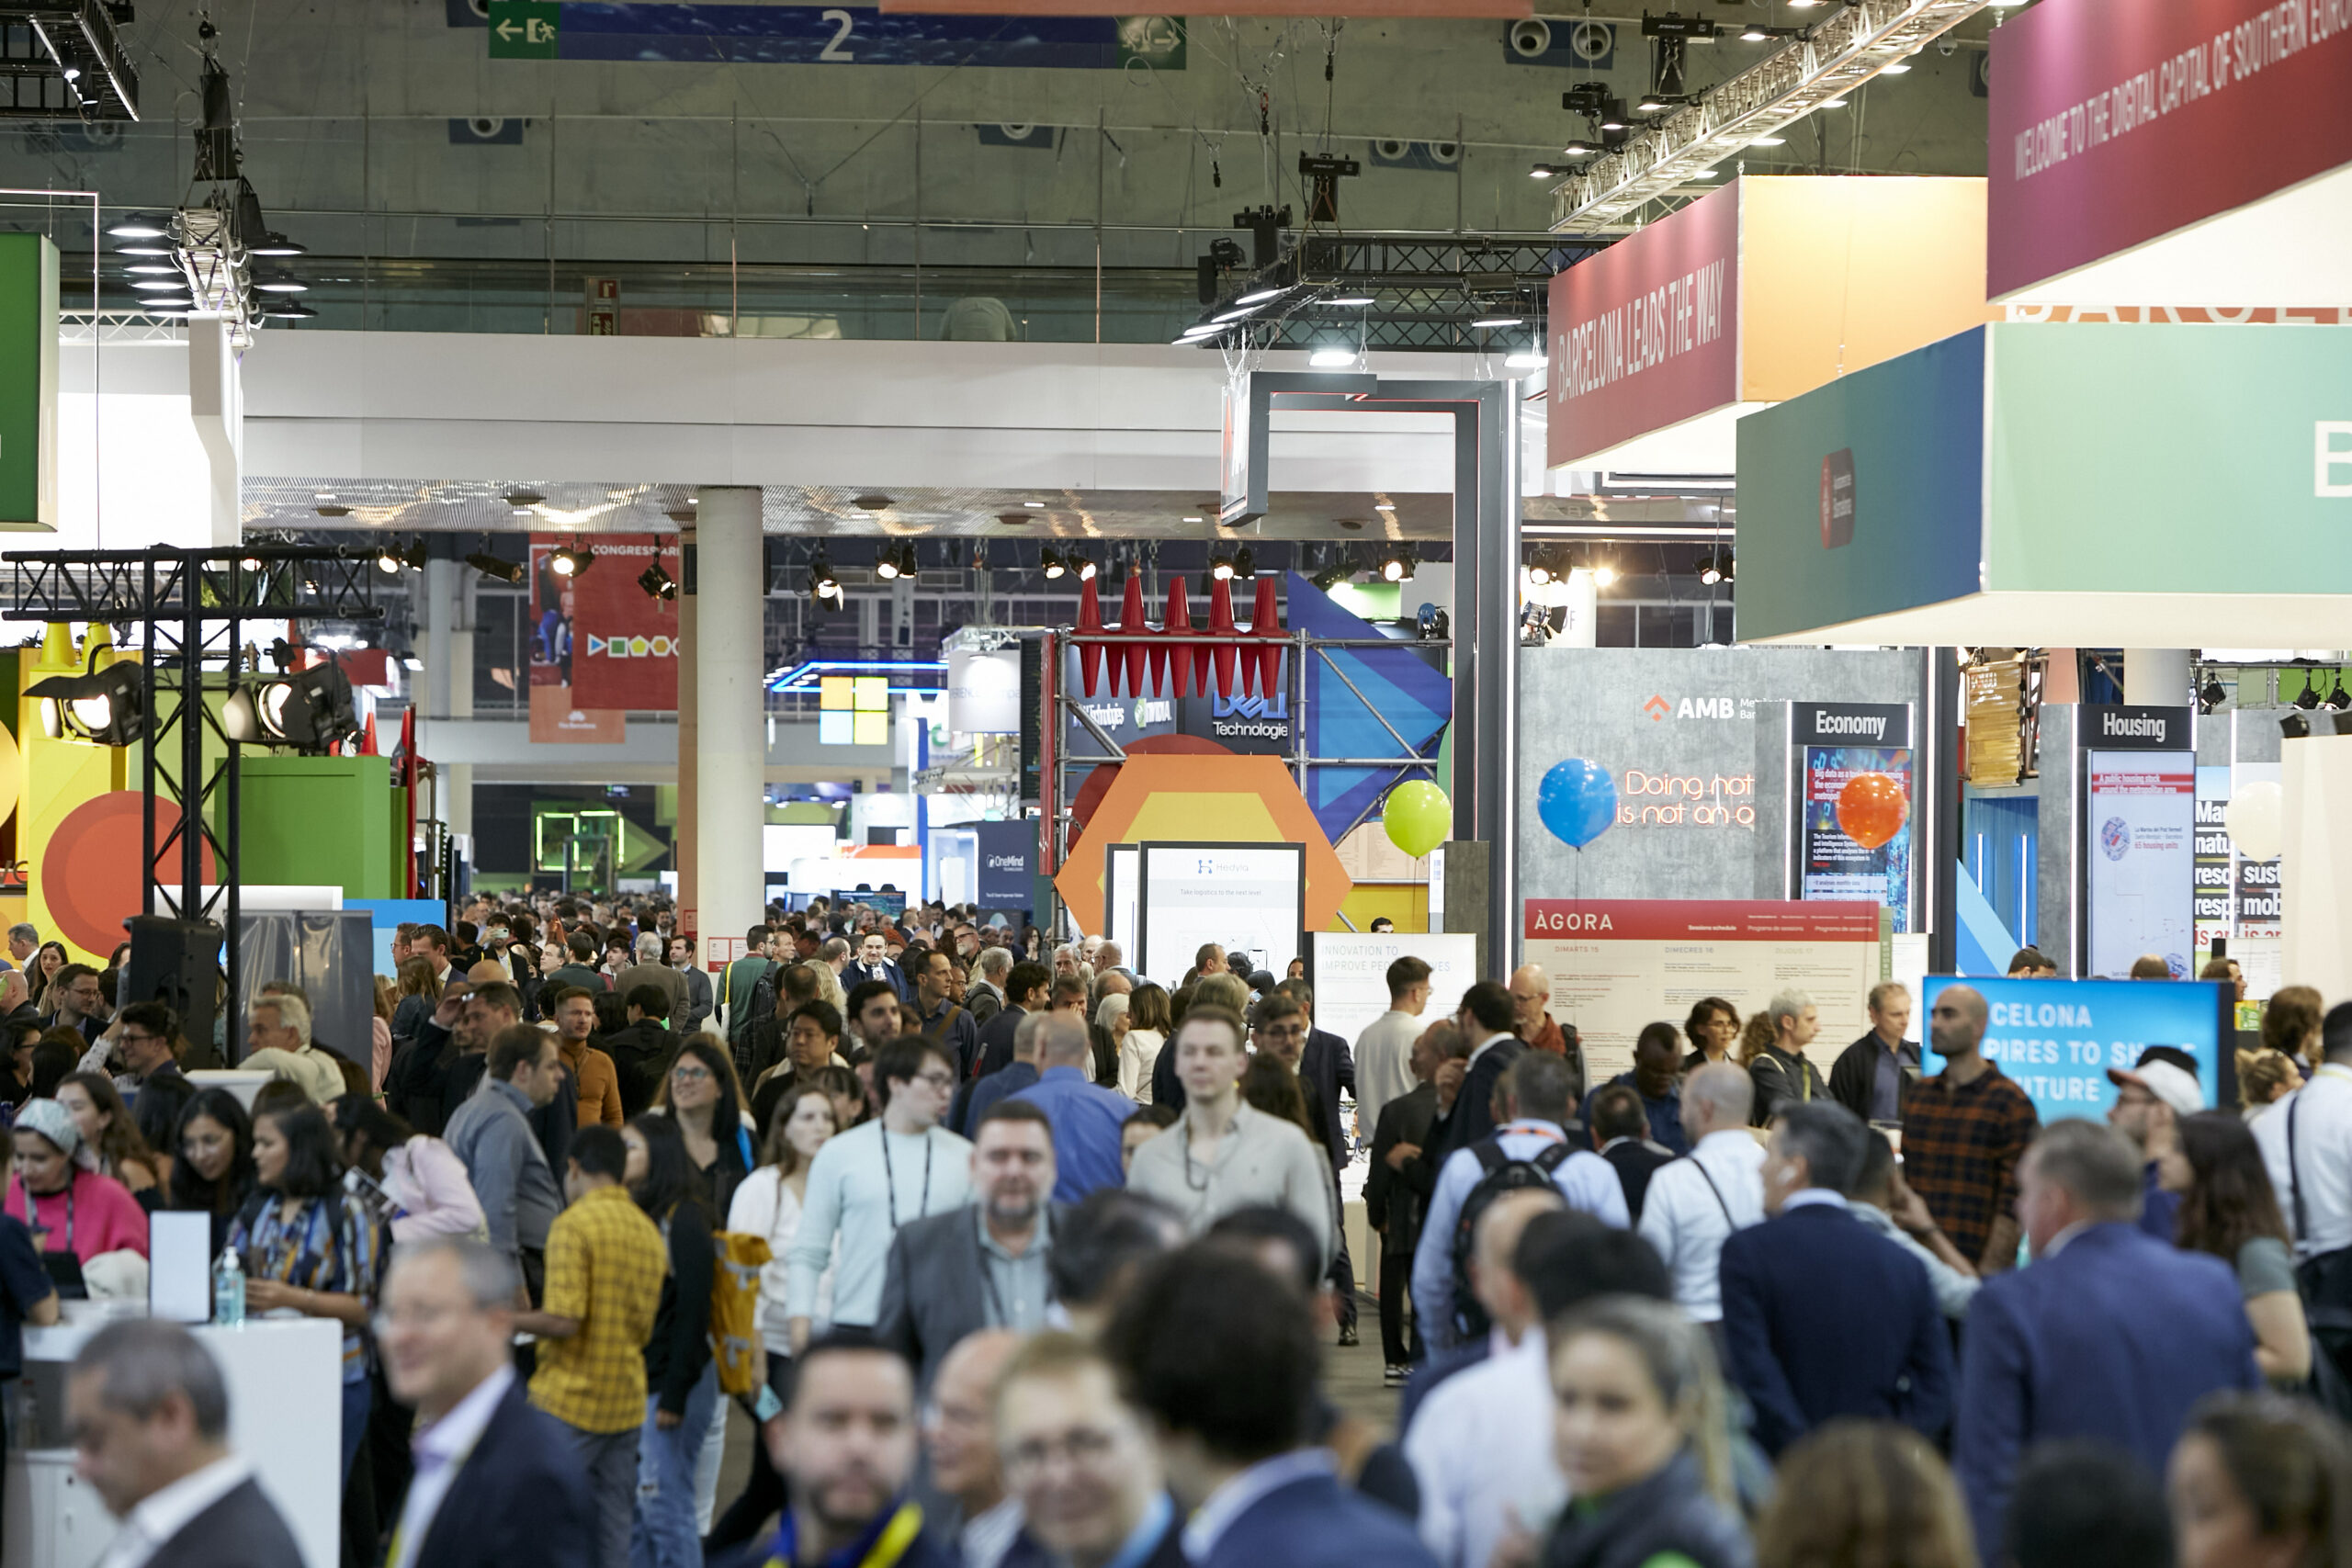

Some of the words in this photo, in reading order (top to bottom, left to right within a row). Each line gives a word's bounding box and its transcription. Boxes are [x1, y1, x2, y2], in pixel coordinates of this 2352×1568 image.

[820, 9, 854, 62] 2
[2015, 109, 2068, 181] WELCOME
[2069, 103, 2086, 156] TO
[2086, 90, 2109, 148] THE
[2111, 68, 2157, 138] DIGITAL
[2159, 42, 2211, 115] CAPITAL
[2212, 29, 2232, 91] OF
[1558, 307, 1624, 403] BARCELONA
[1627, 286, 1667, 376] LEADS
[1668, 273, 1694, 358] THE
[1697, 258, 1725, 346] WAY
[1677, 697, 1735, 719] AMB
[1815, 710, 1887, 741] Economy
[2103, 712, 2166, 743] Housing
[1625, 770, 1704, 801] Doing
[1710, 773, 1756, 796] not
[1616, 803, 1635, 825] is
[1641, 802, 1688, 825] not
[1693, 806, 1731, 825] an
[1181, 888, 1193, 897] Take
[1225, 888, 1234, 897] the
[1533, 909, 1613, 931] ÀGORA
[1321, 945, 1383, 956] INNOVATION
[1385, 946, 1398, 956] TO
[1321, 960, 1367, 971] IMPROVE
[2066, 1040, 2101, 1066] TO
